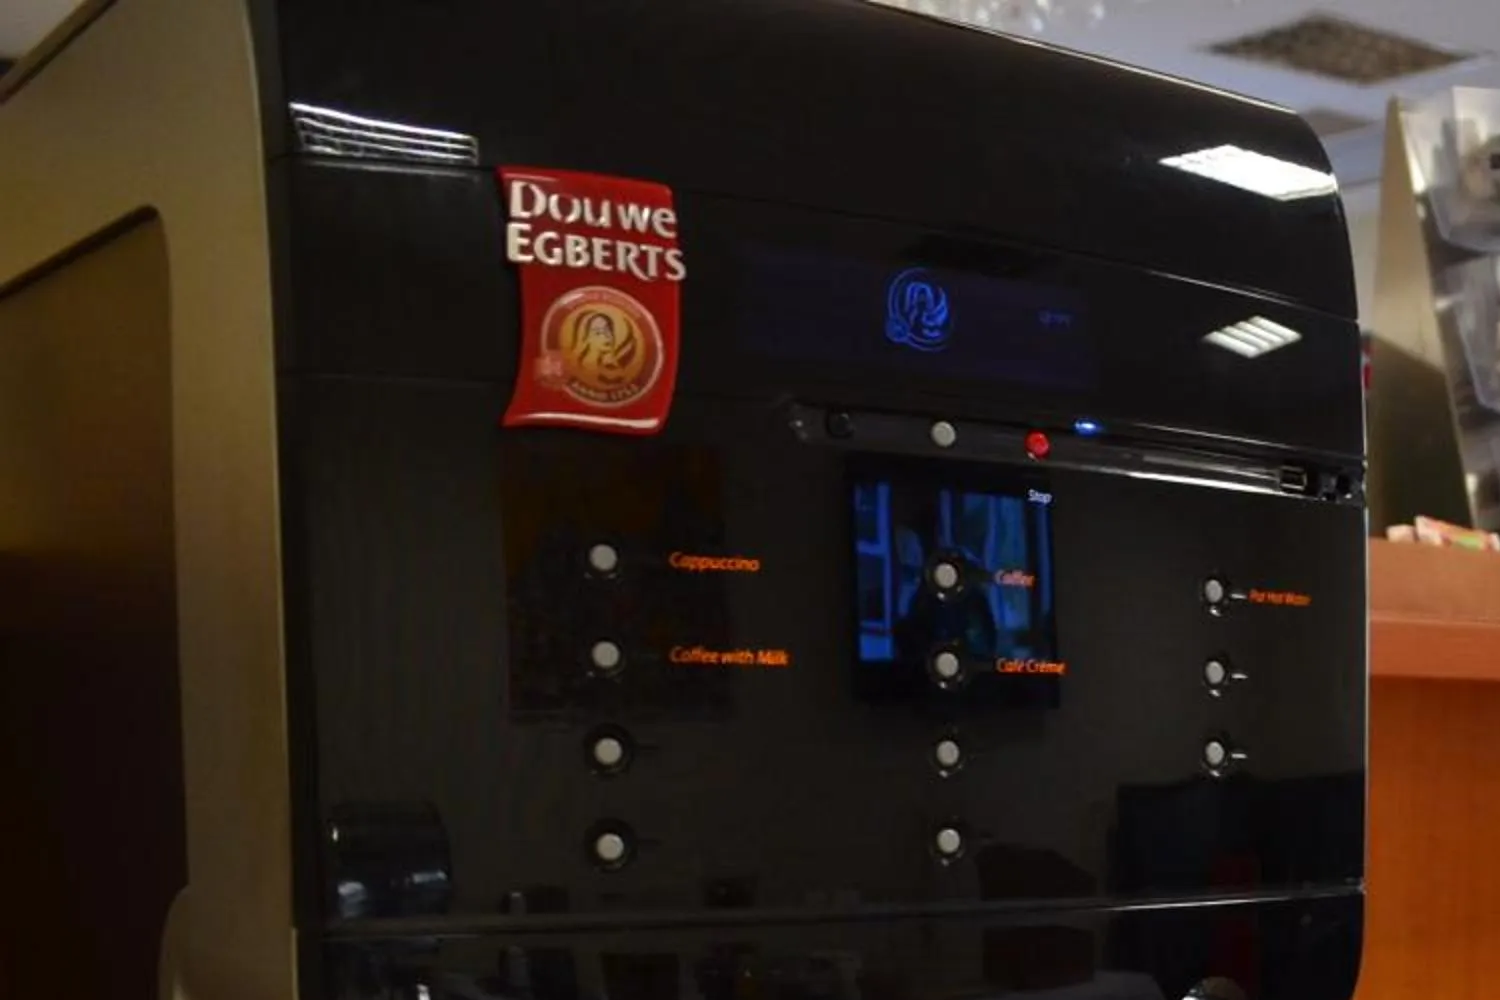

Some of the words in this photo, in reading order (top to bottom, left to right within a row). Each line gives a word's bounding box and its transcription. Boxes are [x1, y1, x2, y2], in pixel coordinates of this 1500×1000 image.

[507, 221, 687, 282] EGBERTS
[1028, 488, 1053, 503] Stop
[669, 551, 760, 572] Cappuccino
[670, 645, 719, 664] Coffee
[721, 648, 754, 665] with
[757, 649, 789, 666] Milk
